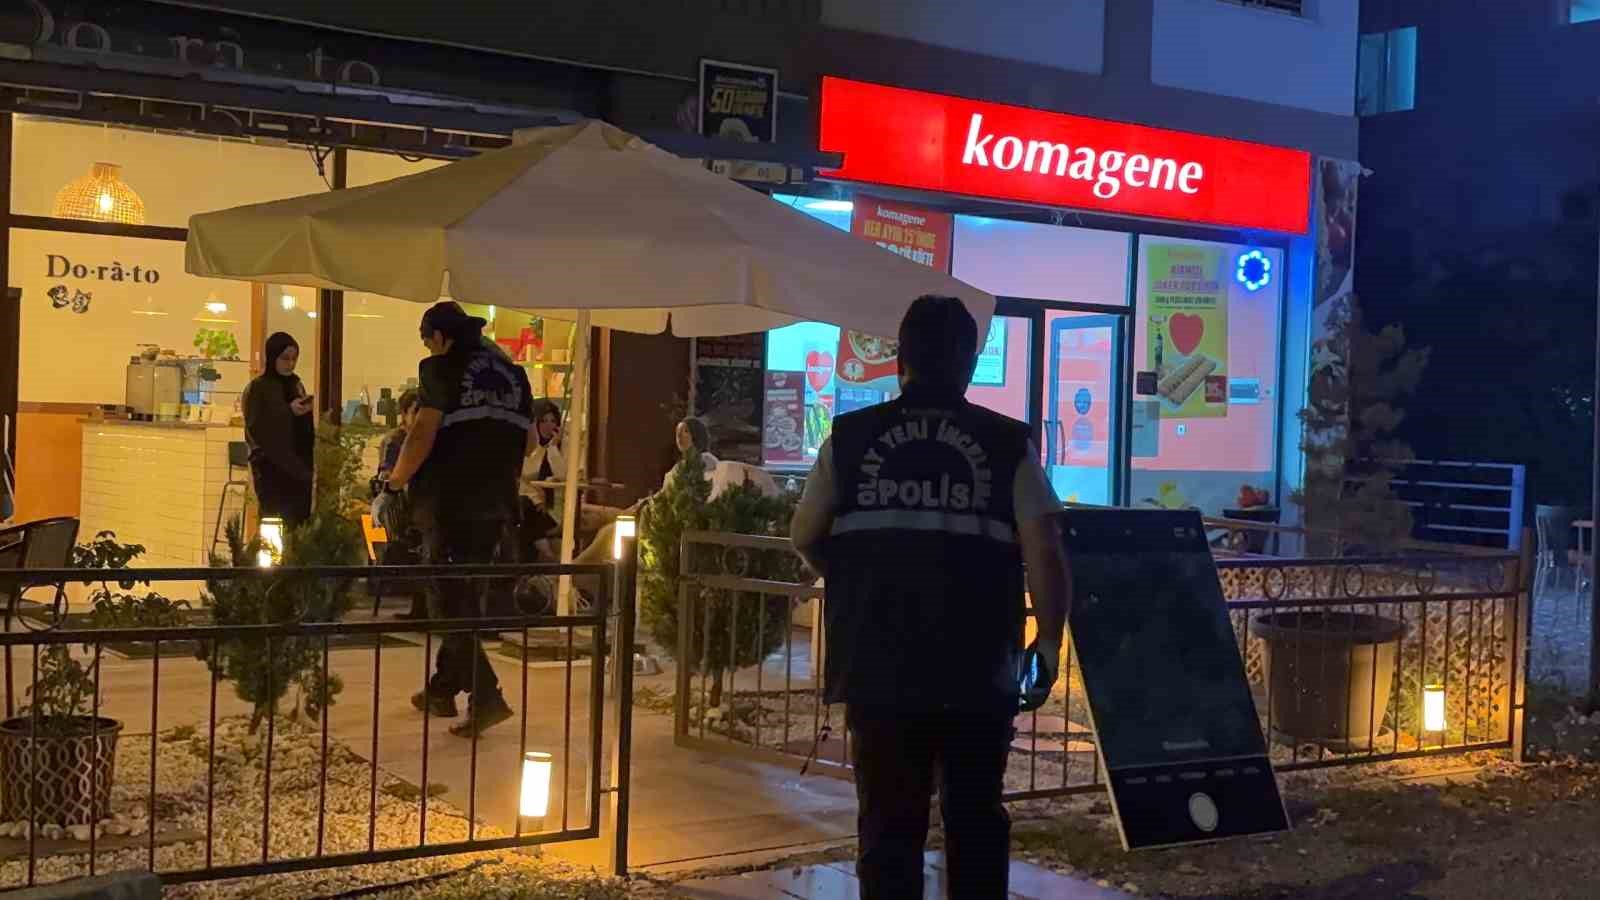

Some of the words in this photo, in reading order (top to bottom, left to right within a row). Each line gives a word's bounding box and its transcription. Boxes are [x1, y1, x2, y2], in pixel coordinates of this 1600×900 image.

[962, 113, 1204, 199] komagene
[876, 205, 926, 226] komagene
[857, 447, 885, 506] OLAY
[878, 472, 970, 509] POLİS
